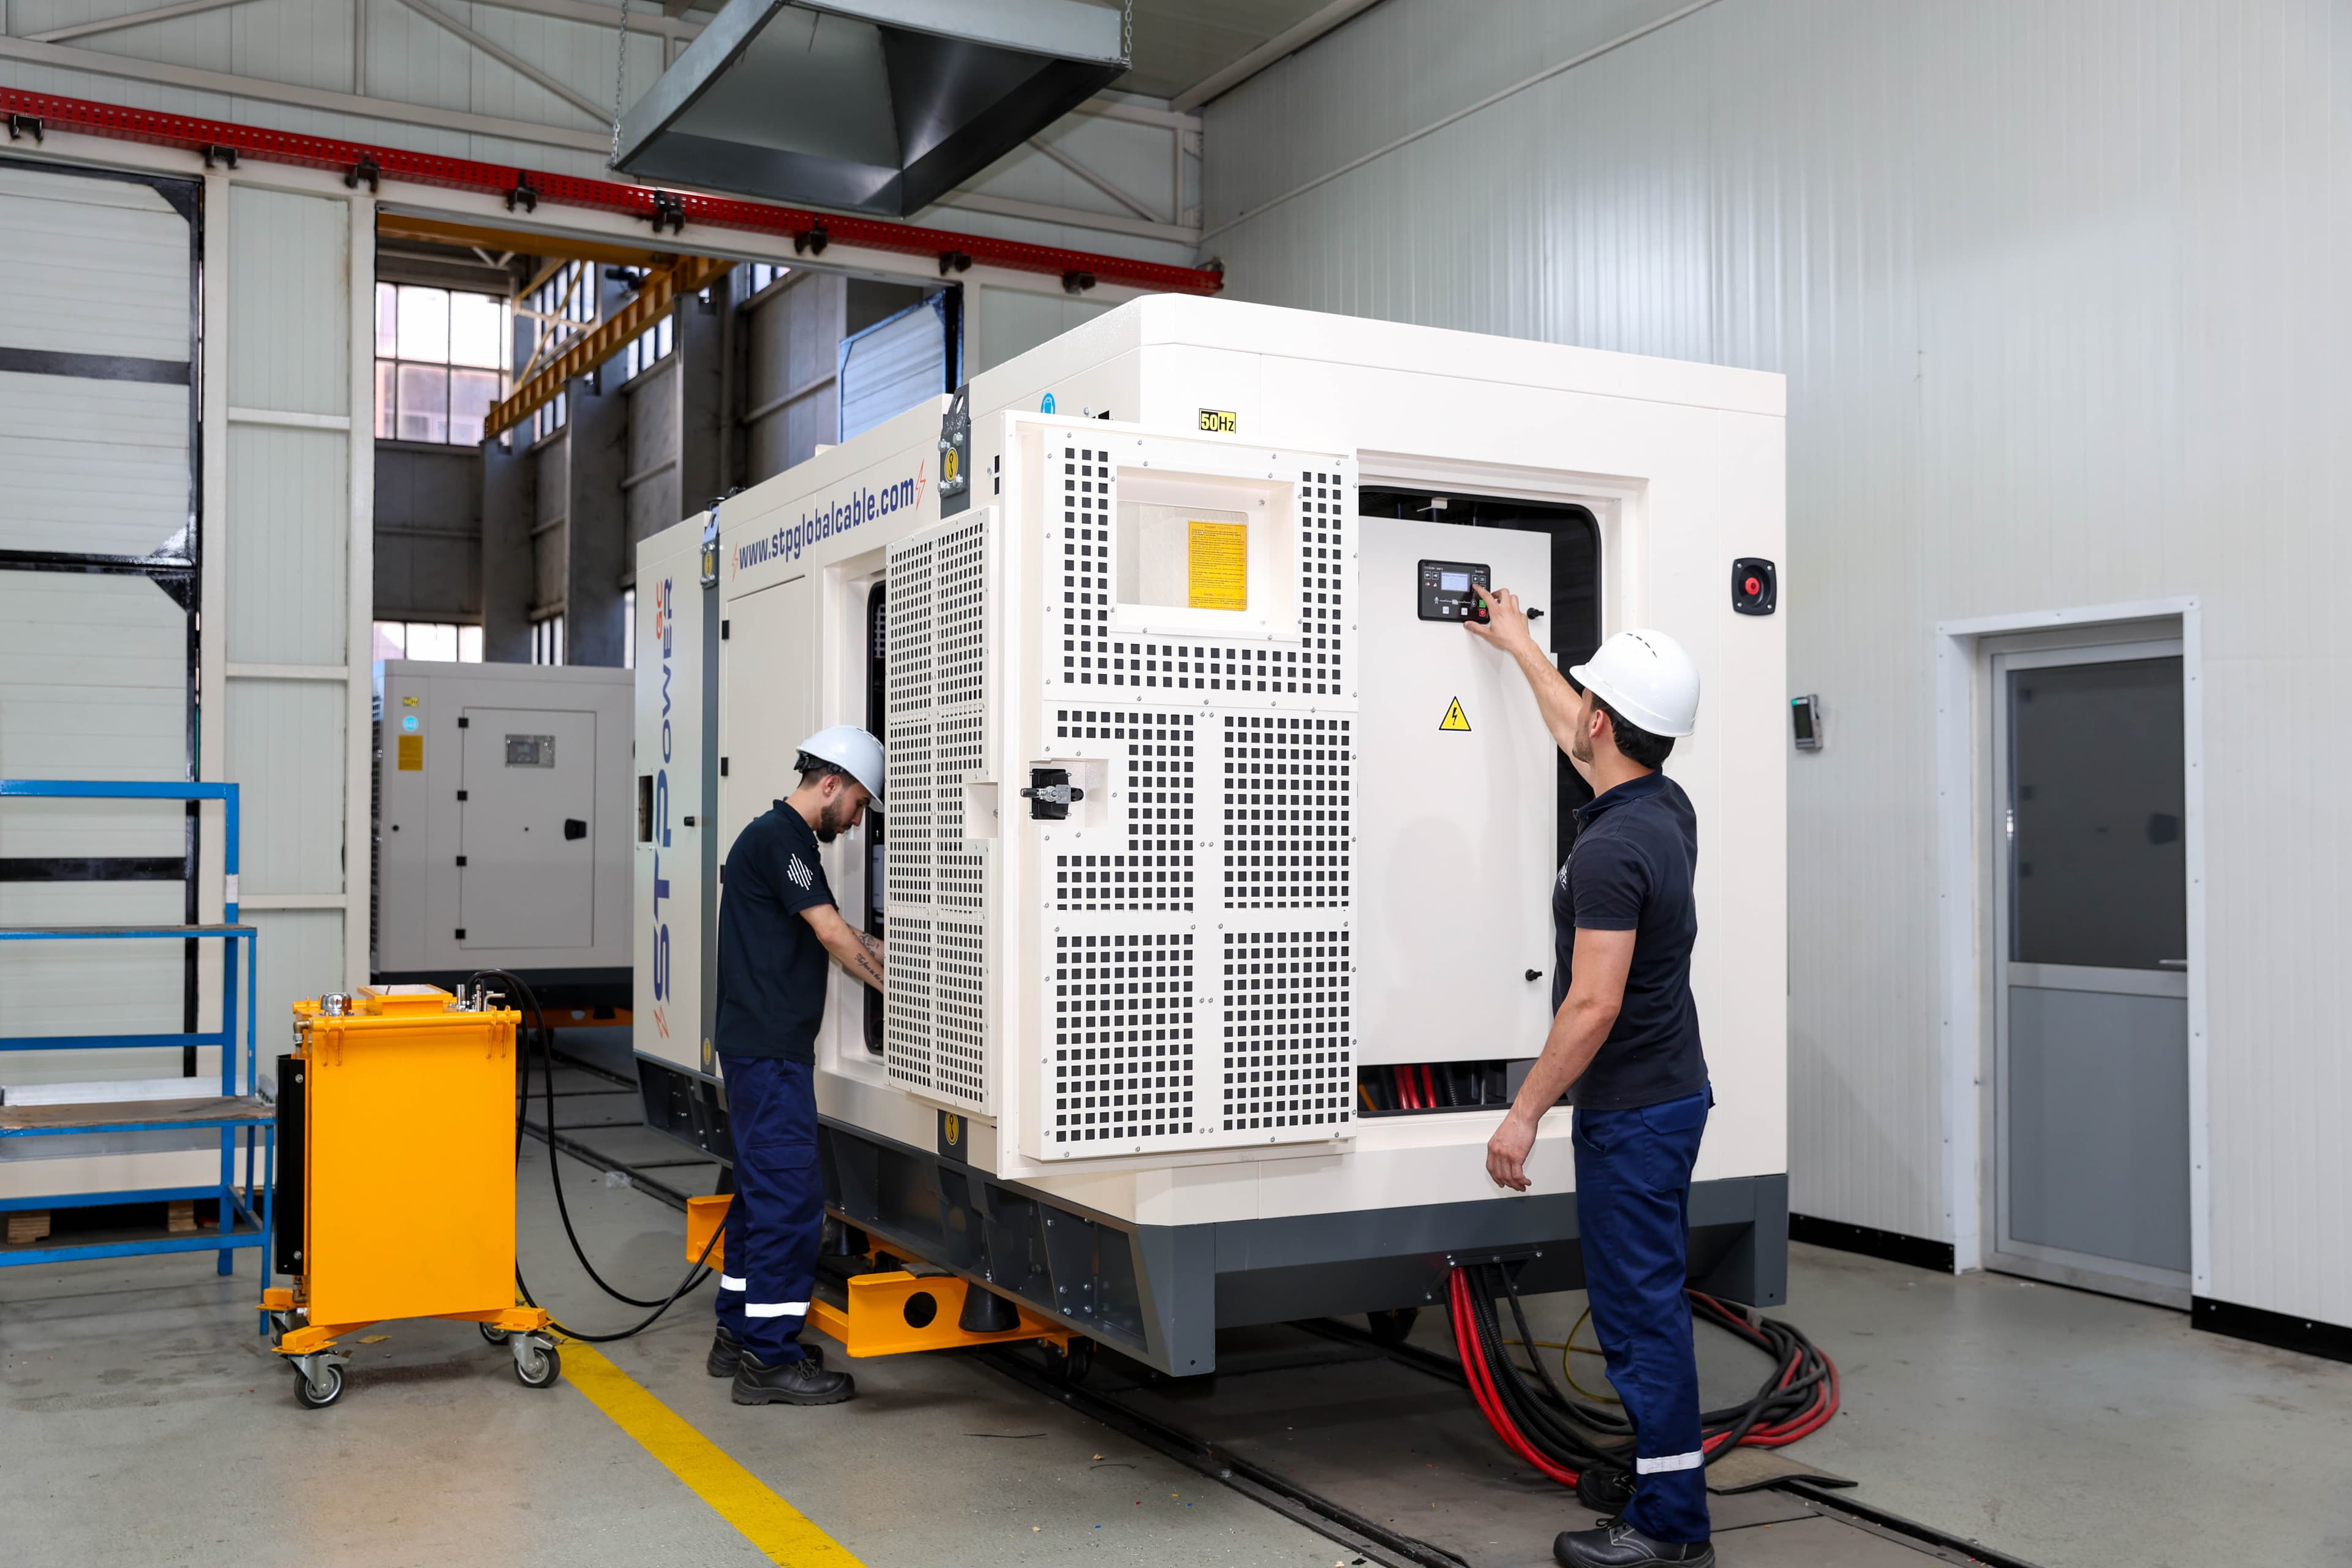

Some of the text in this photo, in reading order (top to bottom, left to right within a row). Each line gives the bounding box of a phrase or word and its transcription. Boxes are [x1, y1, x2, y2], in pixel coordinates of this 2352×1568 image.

[1201, 413, 1234, 431] 50Hz
[739, 477, 914, 570] www.stpglobalcable.com
[656, 581, 663, 639] GC
